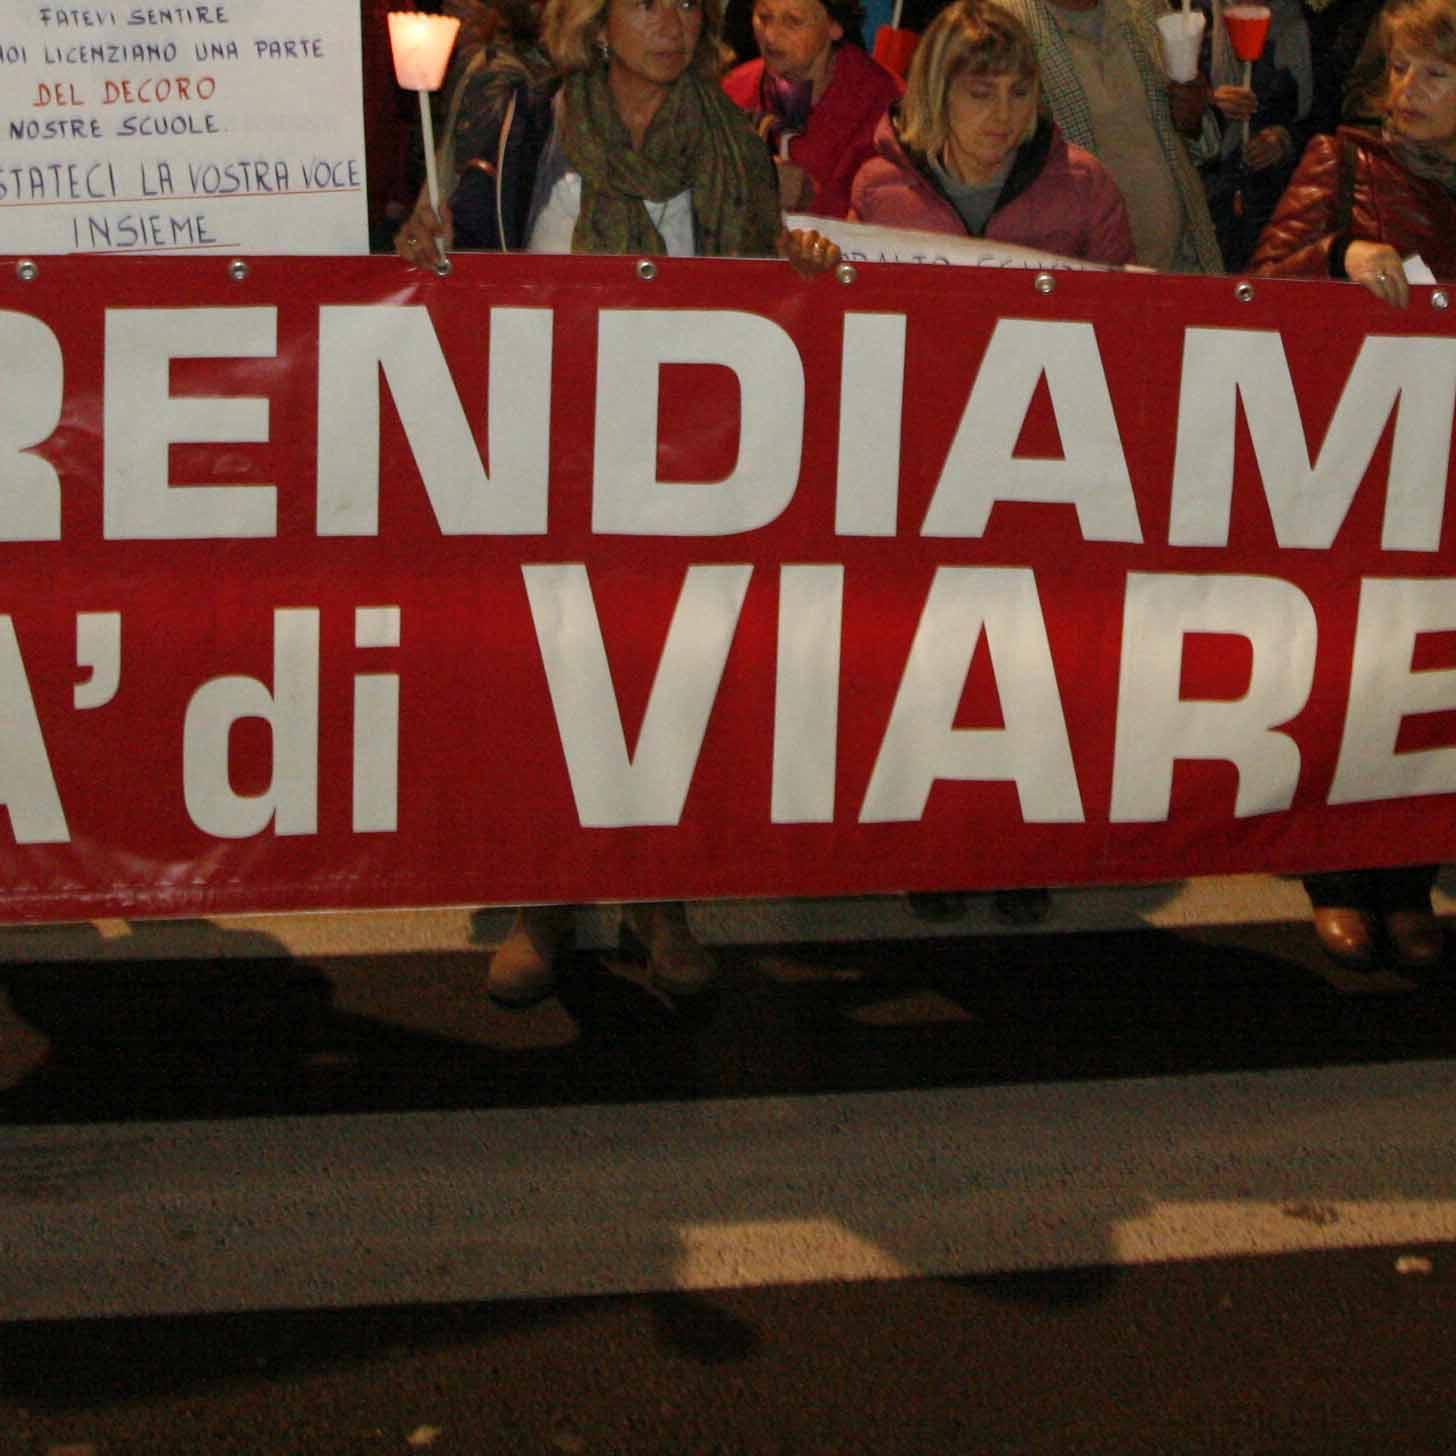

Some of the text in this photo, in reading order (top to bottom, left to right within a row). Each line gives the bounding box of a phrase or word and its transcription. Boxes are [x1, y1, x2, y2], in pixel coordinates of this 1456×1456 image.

[39, 4, 229, 27] FATEVI SENTIRE
[44, 41, 178, 65] LICENZIANO
[194, 41, 239, 61] UNA
[255, 39, 325, 59] PARTE
[32, 75, 216, 107] DEL DECORO
[9, 116, 104, 140] NOSTRE
[140, 163, 174, 197] LA
[189, 160, 290, 195] VOSTRA
[302, 158, 362, 190] VOCE
[72, 214, 217, 248] INSIEME
[182, 605, 401, 838] di
